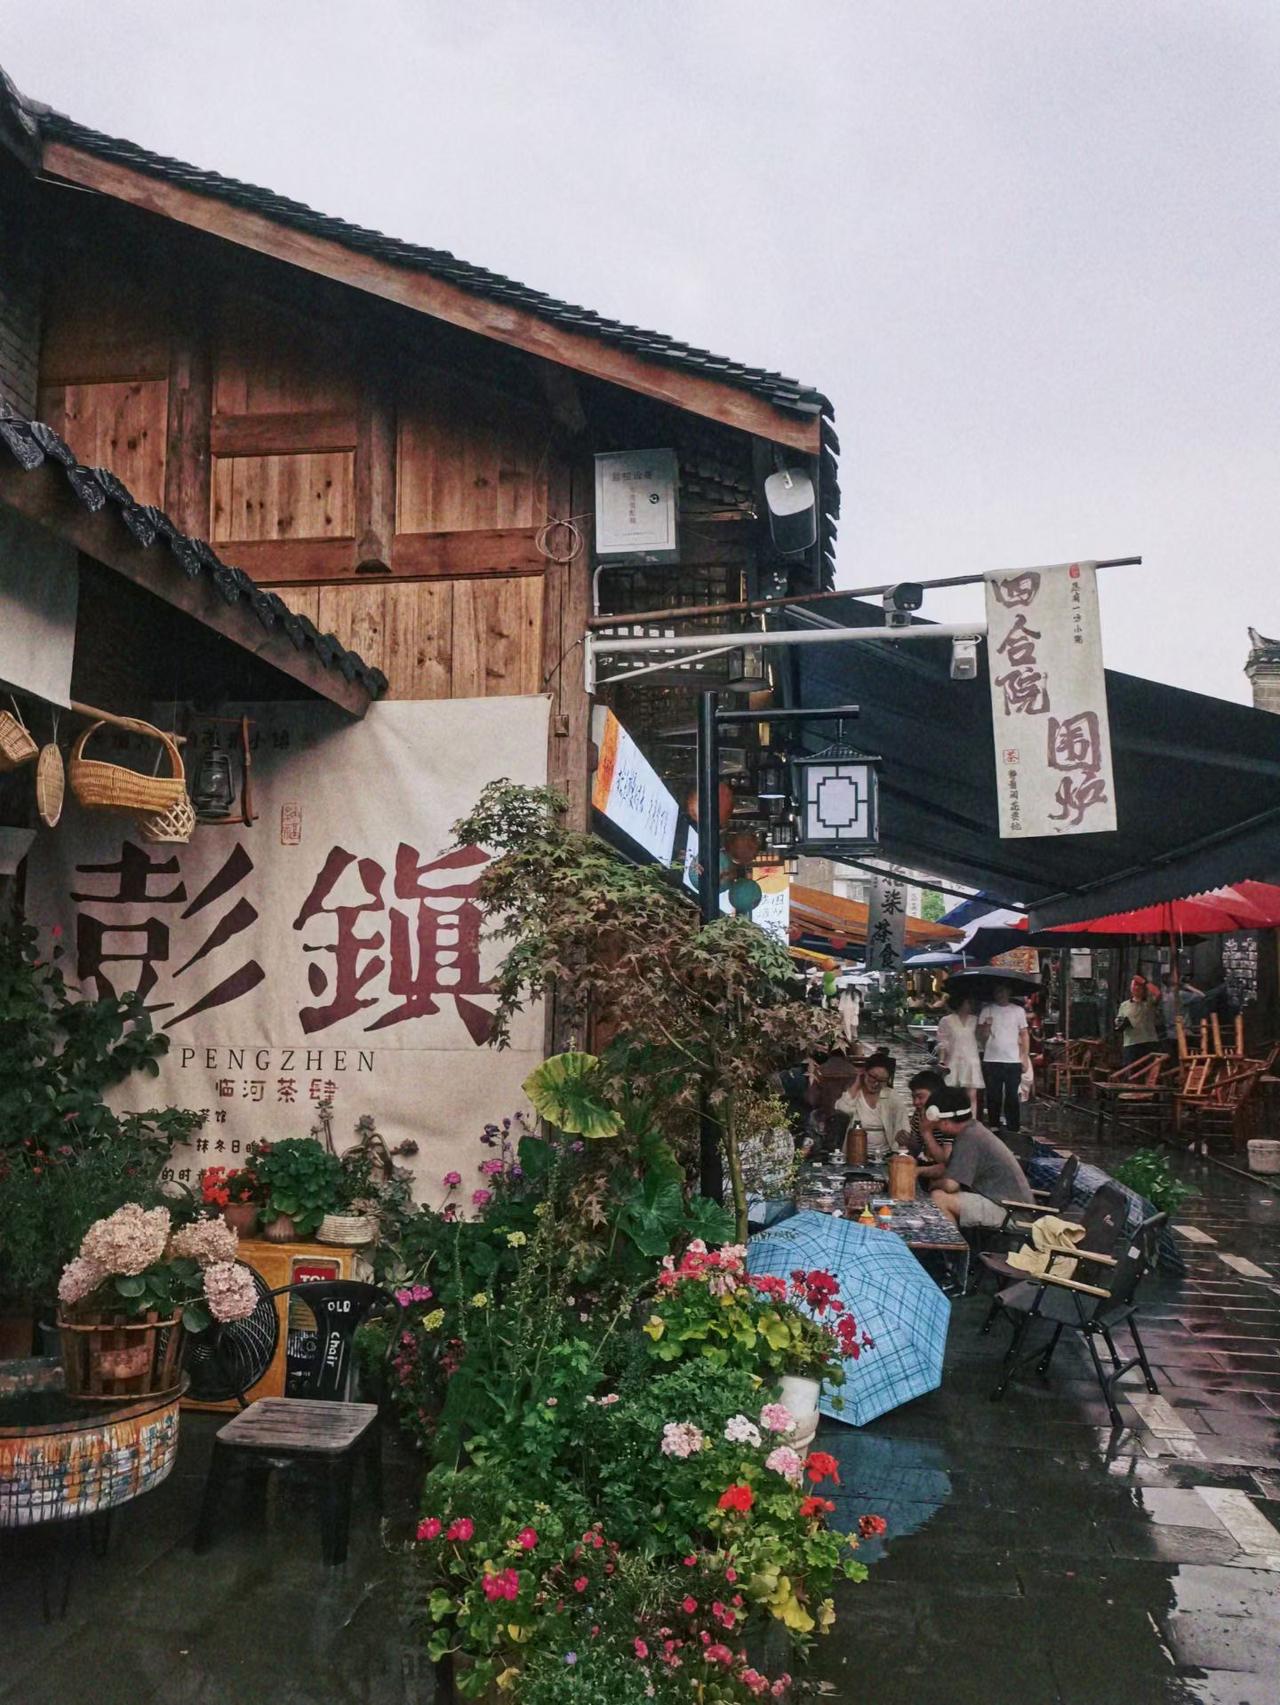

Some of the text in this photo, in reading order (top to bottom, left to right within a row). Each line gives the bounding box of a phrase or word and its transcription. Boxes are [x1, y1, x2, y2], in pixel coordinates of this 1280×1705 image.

[991, 571, 1051, 716] 四合院
[1046, 710, 1108, 833] 围炉
[180, 1047, 377, 1072] PENGZHEN
[215, 1077, 339, 1103] 临河茶肆
[327, 1300, 351, 1313] OLD
